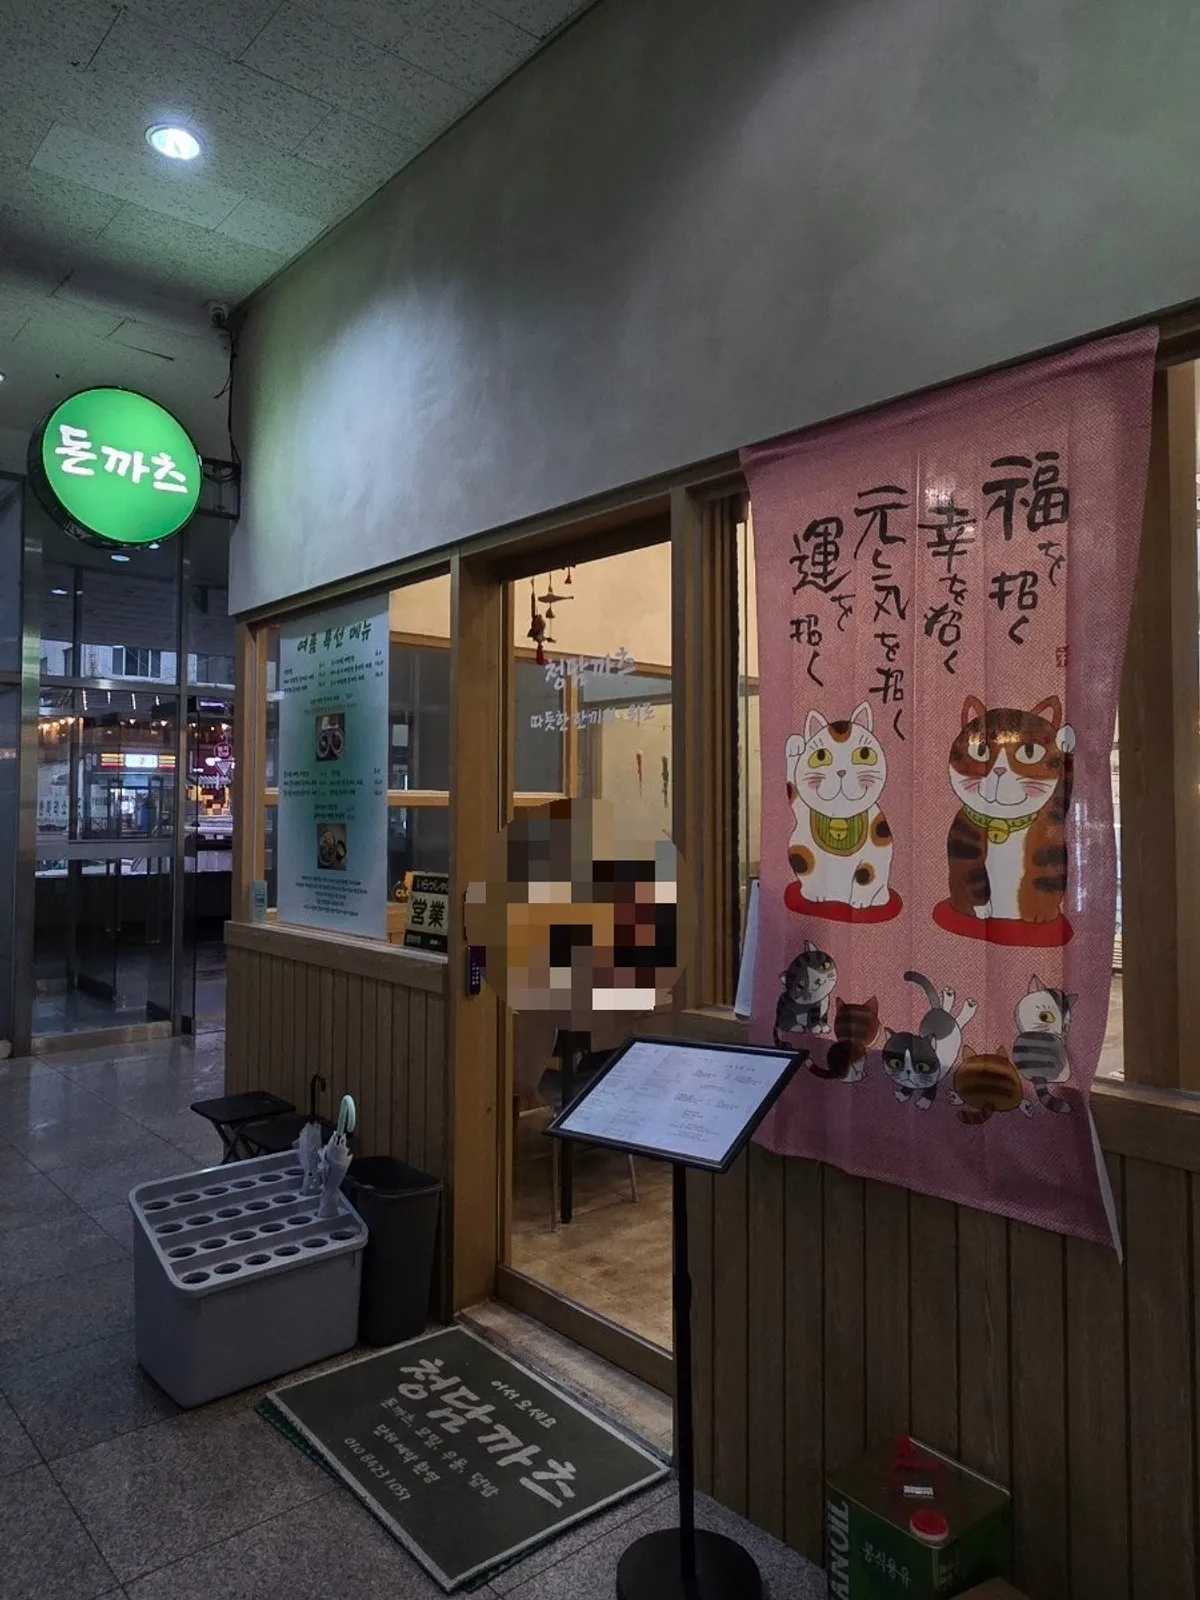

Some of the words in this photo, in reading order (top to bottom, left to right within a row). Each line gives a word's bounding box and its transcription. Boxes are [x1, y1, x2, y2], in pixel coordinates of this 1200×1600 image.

[54, 424, 188, 493] 돈까츠
[982, 451, 1070, 645] 福を招く
[789, 517, 857, 687] 運を招く
[349, 620, 372, 642] 메뉴
[545, 647, 636, 690] 청담까츠
[530, 710, 569, 731] 따뜻한
[411, 898, 446, 928] 営業
[490, 1379, 517, 1402] 어서
[397, 1357, 579, 1509] 청담까츠
[344, 1437, 366, 1454] 010
[360, 1453, 391, 1479] 8423
